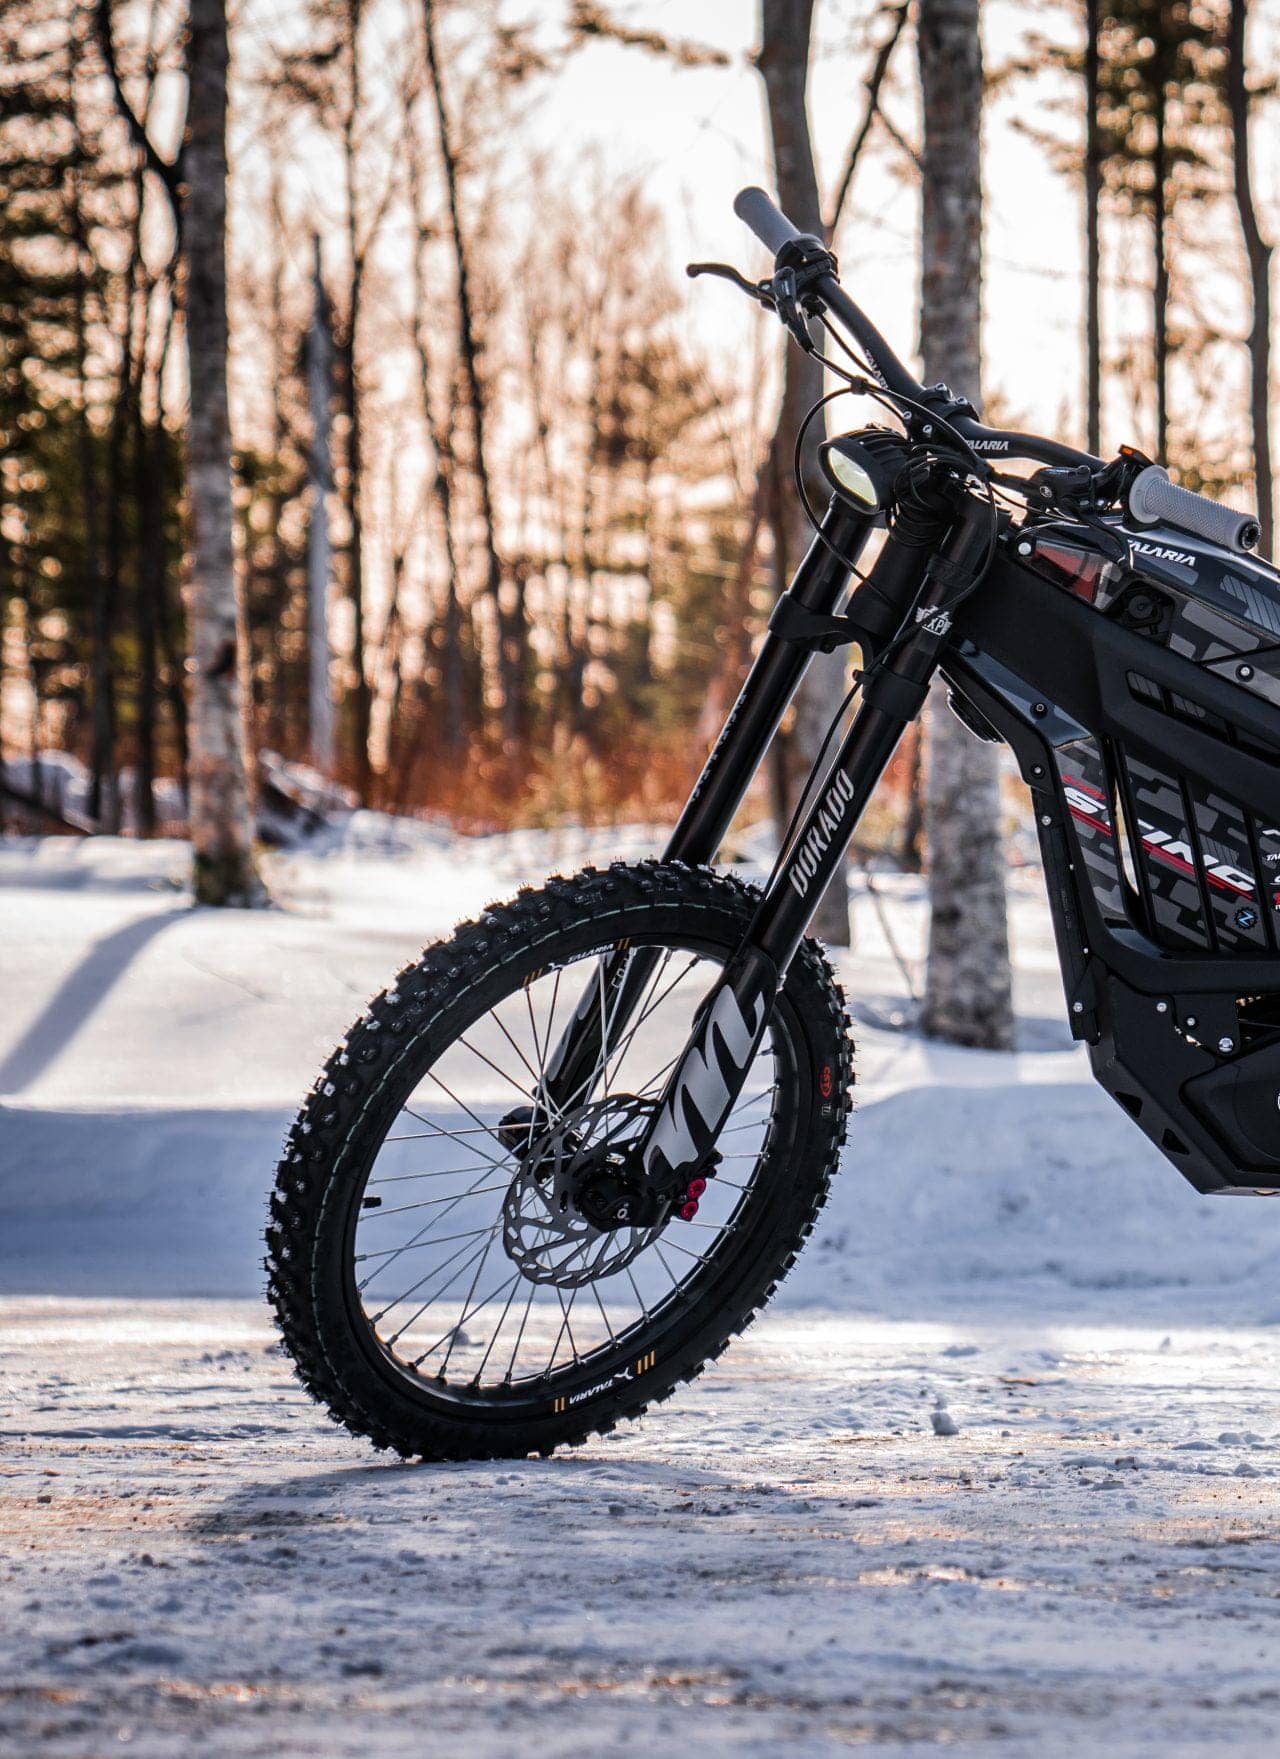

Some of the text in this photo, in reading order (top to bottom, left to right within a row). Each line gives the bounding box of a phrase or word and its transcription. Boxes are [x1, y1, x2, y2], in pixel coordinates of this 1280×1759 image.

[966, 440, 1009, 450] ALARIA
[789, 768, 854, 897] DORADO
[569, 1379, 614, 1405] TALARIA
